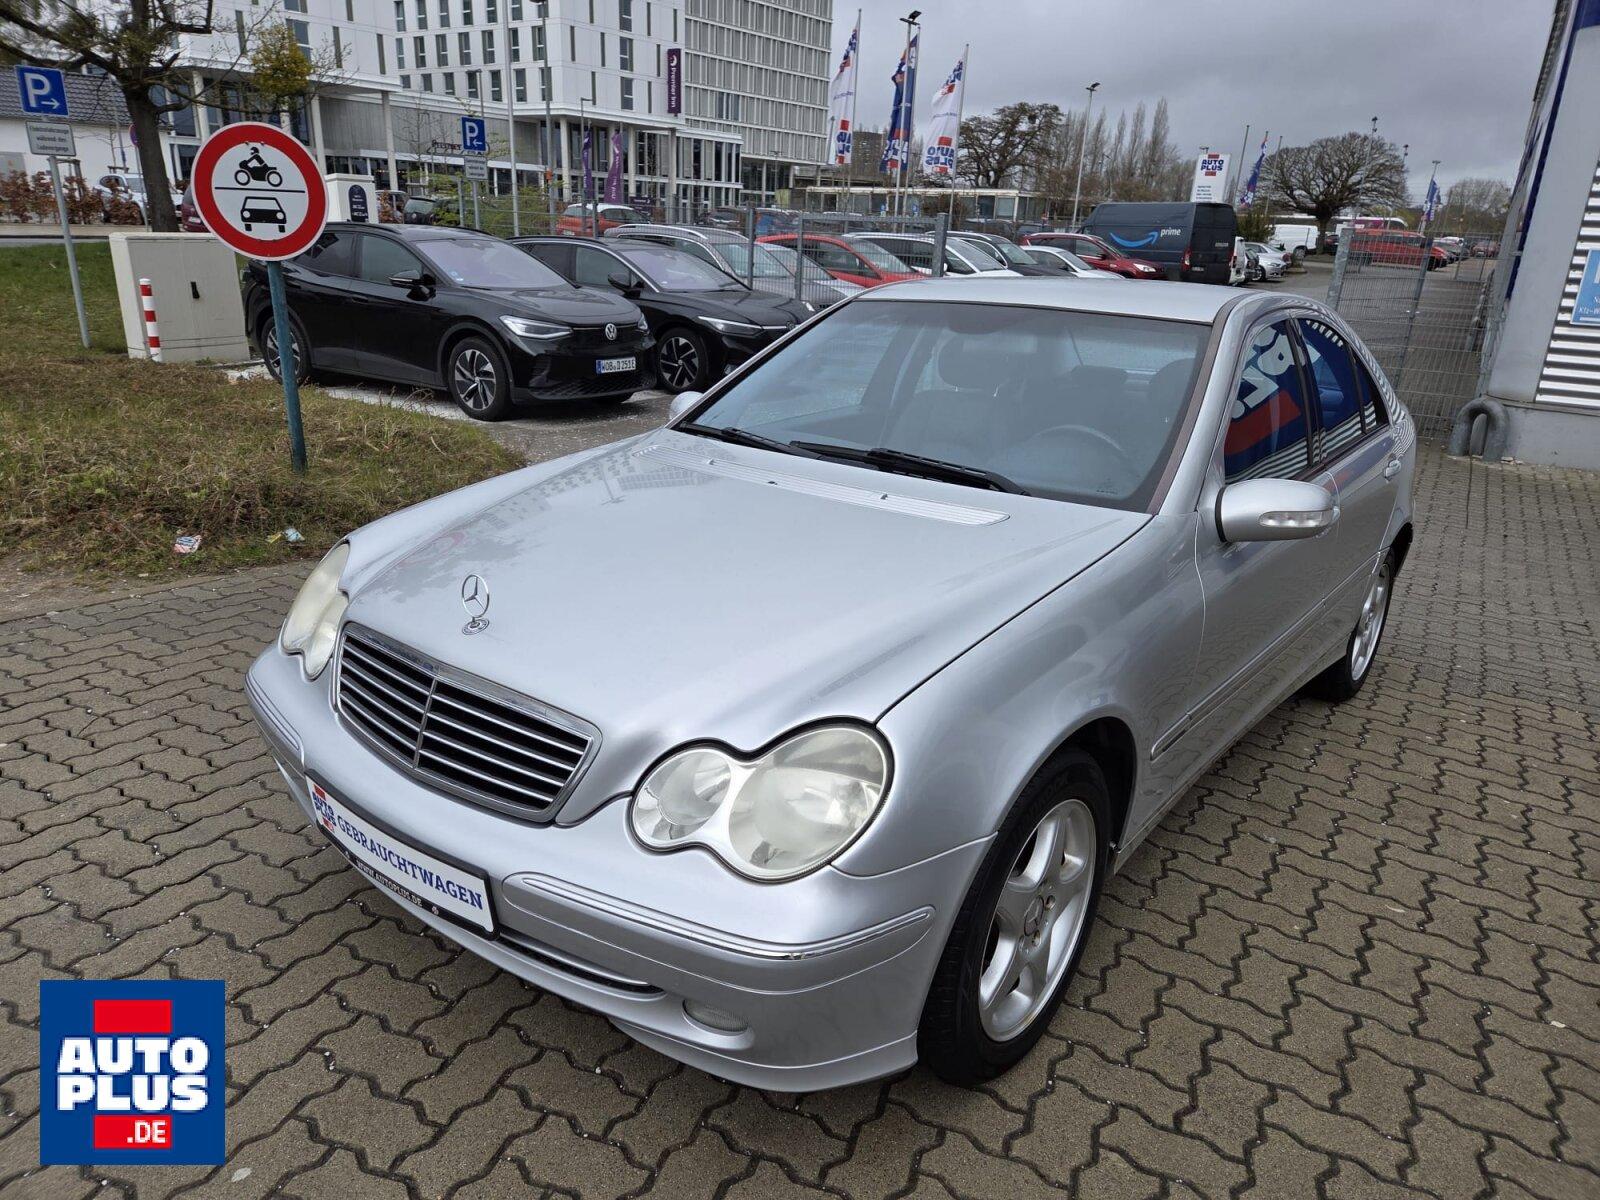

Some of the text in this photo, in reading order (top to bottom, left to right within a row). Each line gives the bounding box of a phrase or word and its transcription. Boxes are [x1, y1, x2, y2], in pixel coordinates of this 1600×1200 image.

[24, 72, 51, 107] P
[465, 121, 479, 146] P
[1160, 227, 1181, 238] prime
[312, 791, 334, 816] AUTO
[337, 815, 483, 910] GEBRAUCHTWAGEN
